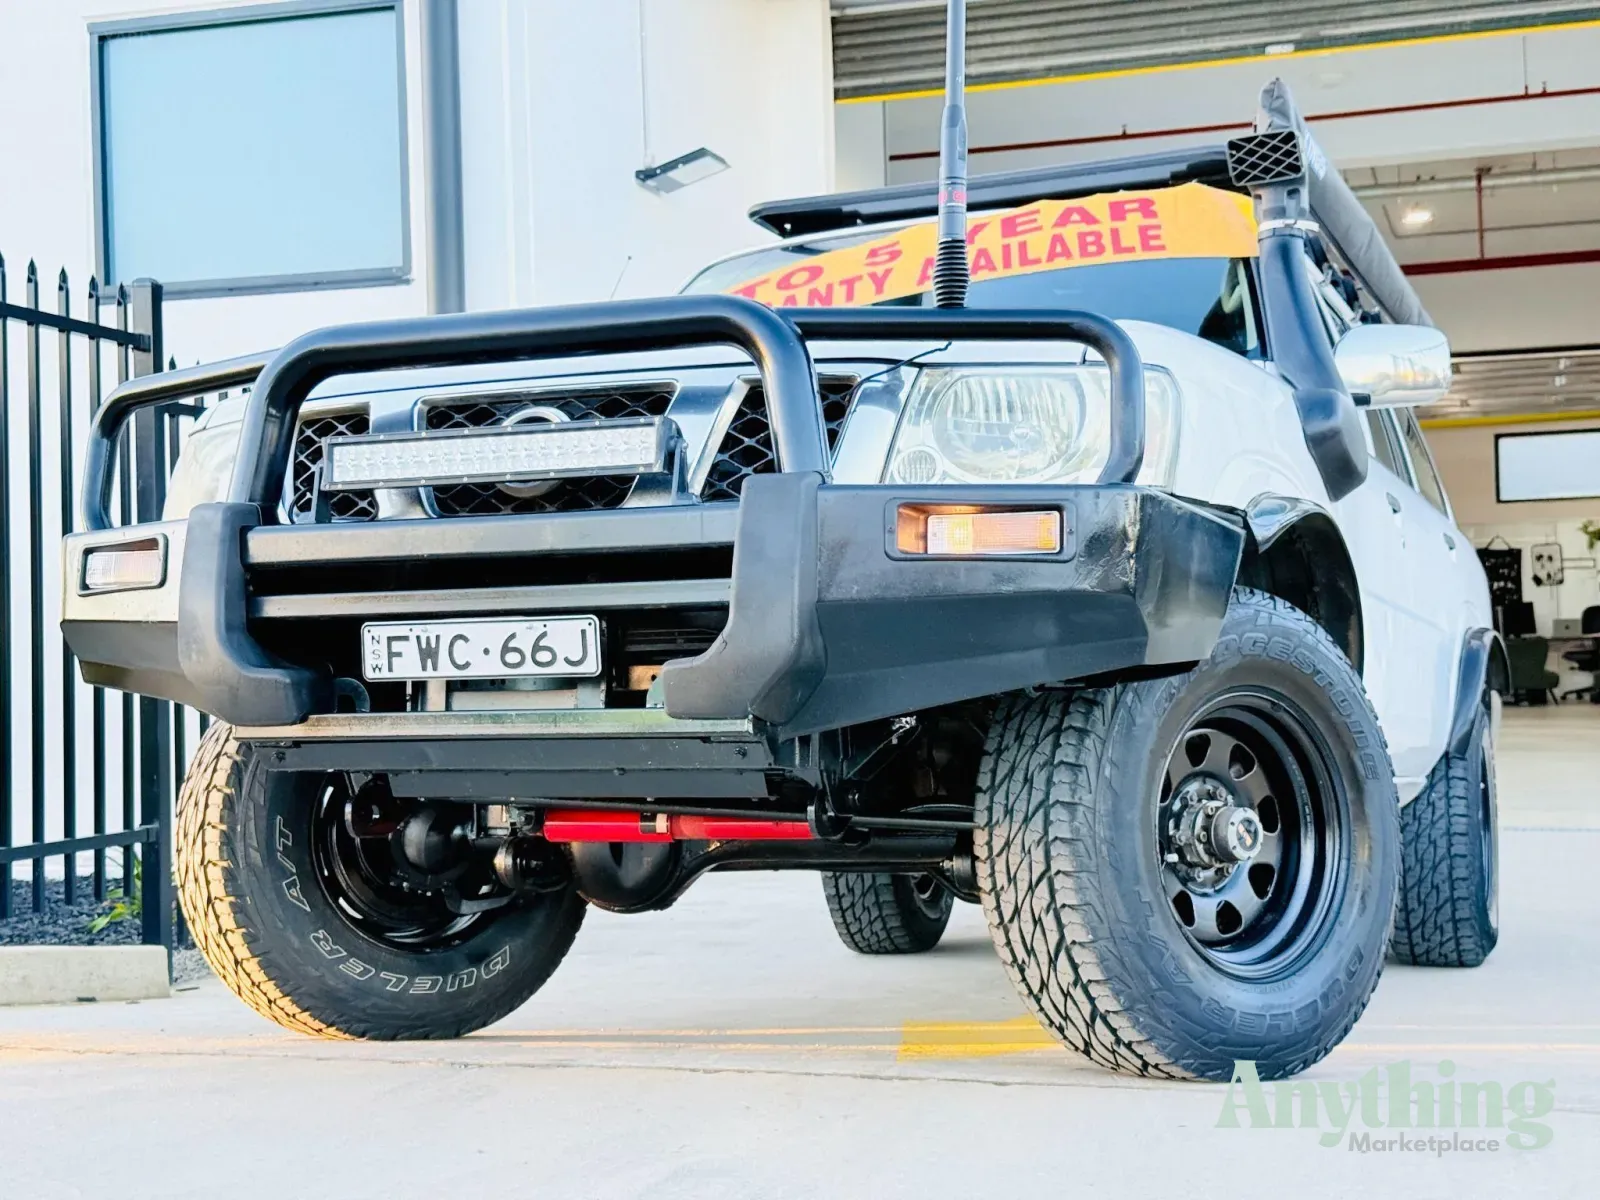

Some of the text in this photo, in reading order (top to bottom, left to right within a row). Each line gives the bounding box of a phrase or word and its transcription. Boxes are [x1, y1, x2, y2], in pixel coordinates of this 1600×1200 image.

[863, 241, 903, 267] 5
[916, 225, 1166, 286] AAILABLE
[275, 815, 510, 994] DUELER A/T
[1201, 943, 1365, 1036] DUELER
